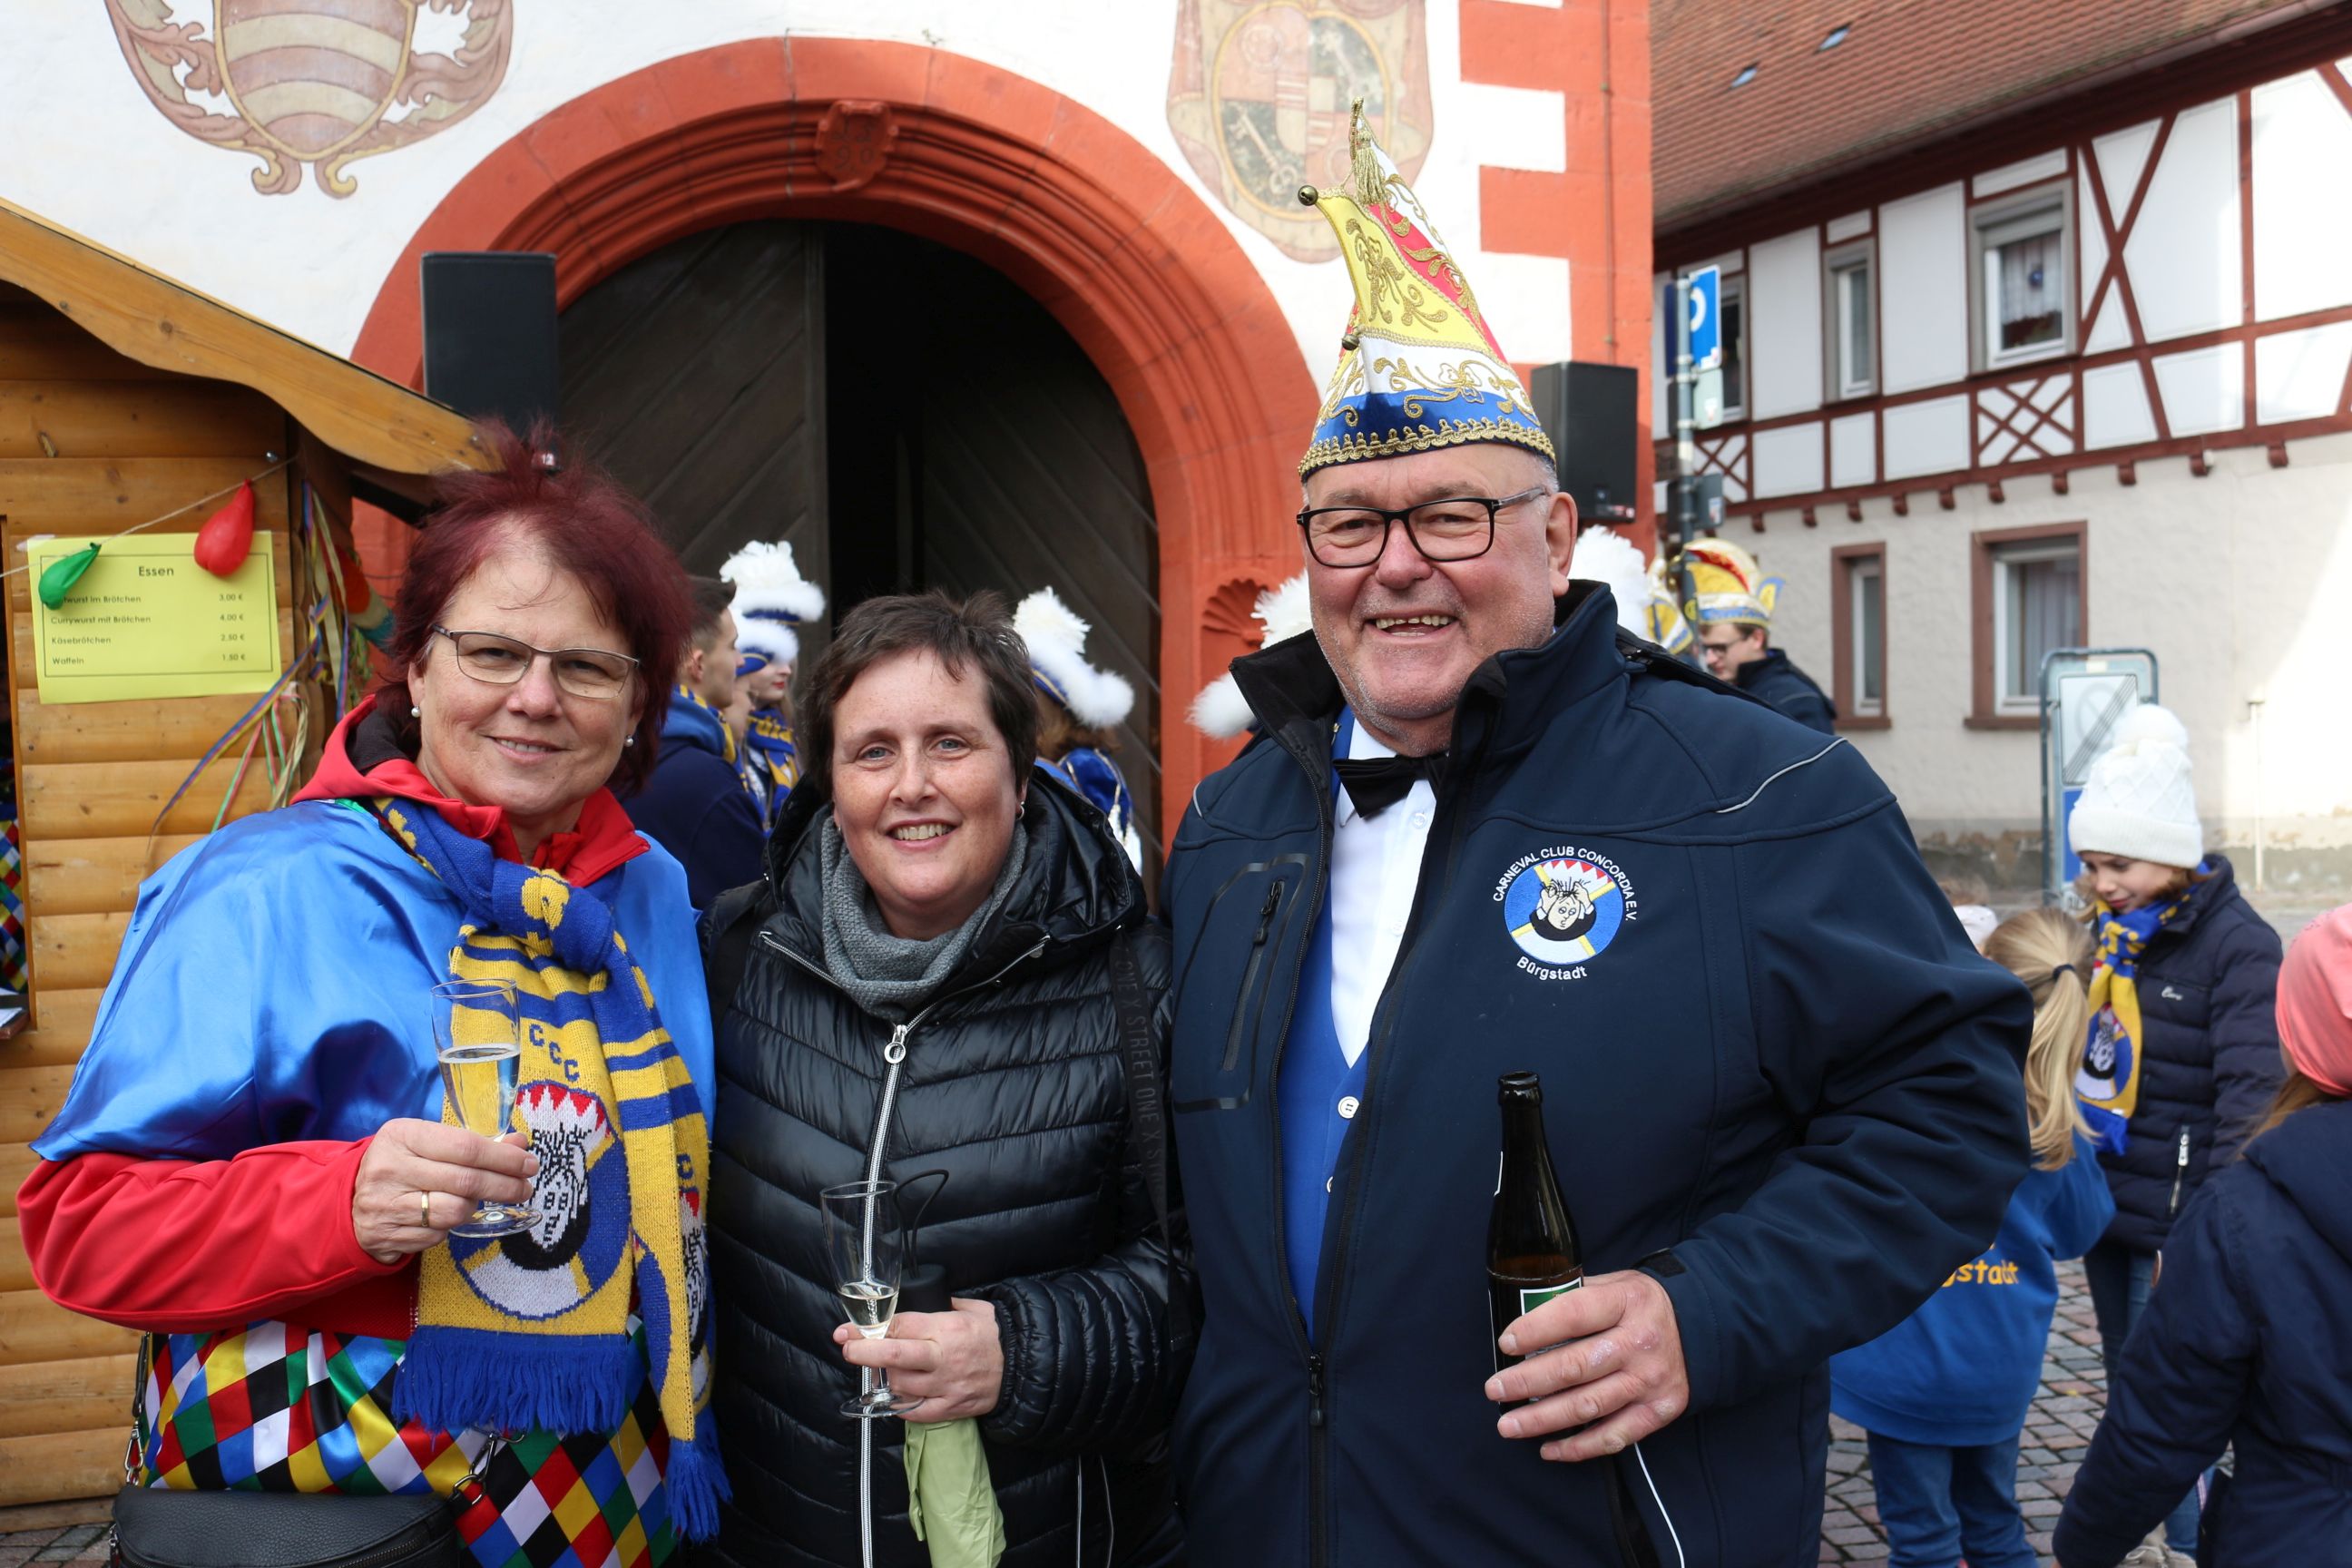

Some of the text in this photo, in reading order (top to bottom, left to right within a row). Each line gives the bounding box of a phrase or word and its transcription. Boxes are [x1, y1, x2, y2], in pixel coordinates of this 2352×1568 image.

[138, 565, 174, 577] Essen
[103, 595, 142, 604] Brötchen
[51, 616, 96, 626] Currywurst
[98, 616, 112, 624] mit
[113, 615, 152, 624] Brötchen
[53, 656, 84, 666] Waffeln
[1493, 852, 1540, 902] CARNEVAL
[1540, 846, 1574, 858] CLUB
[1577, 848, 1636, 899] CONCORDIA
[1516, 956, 1588, 981] Bürgstadt
